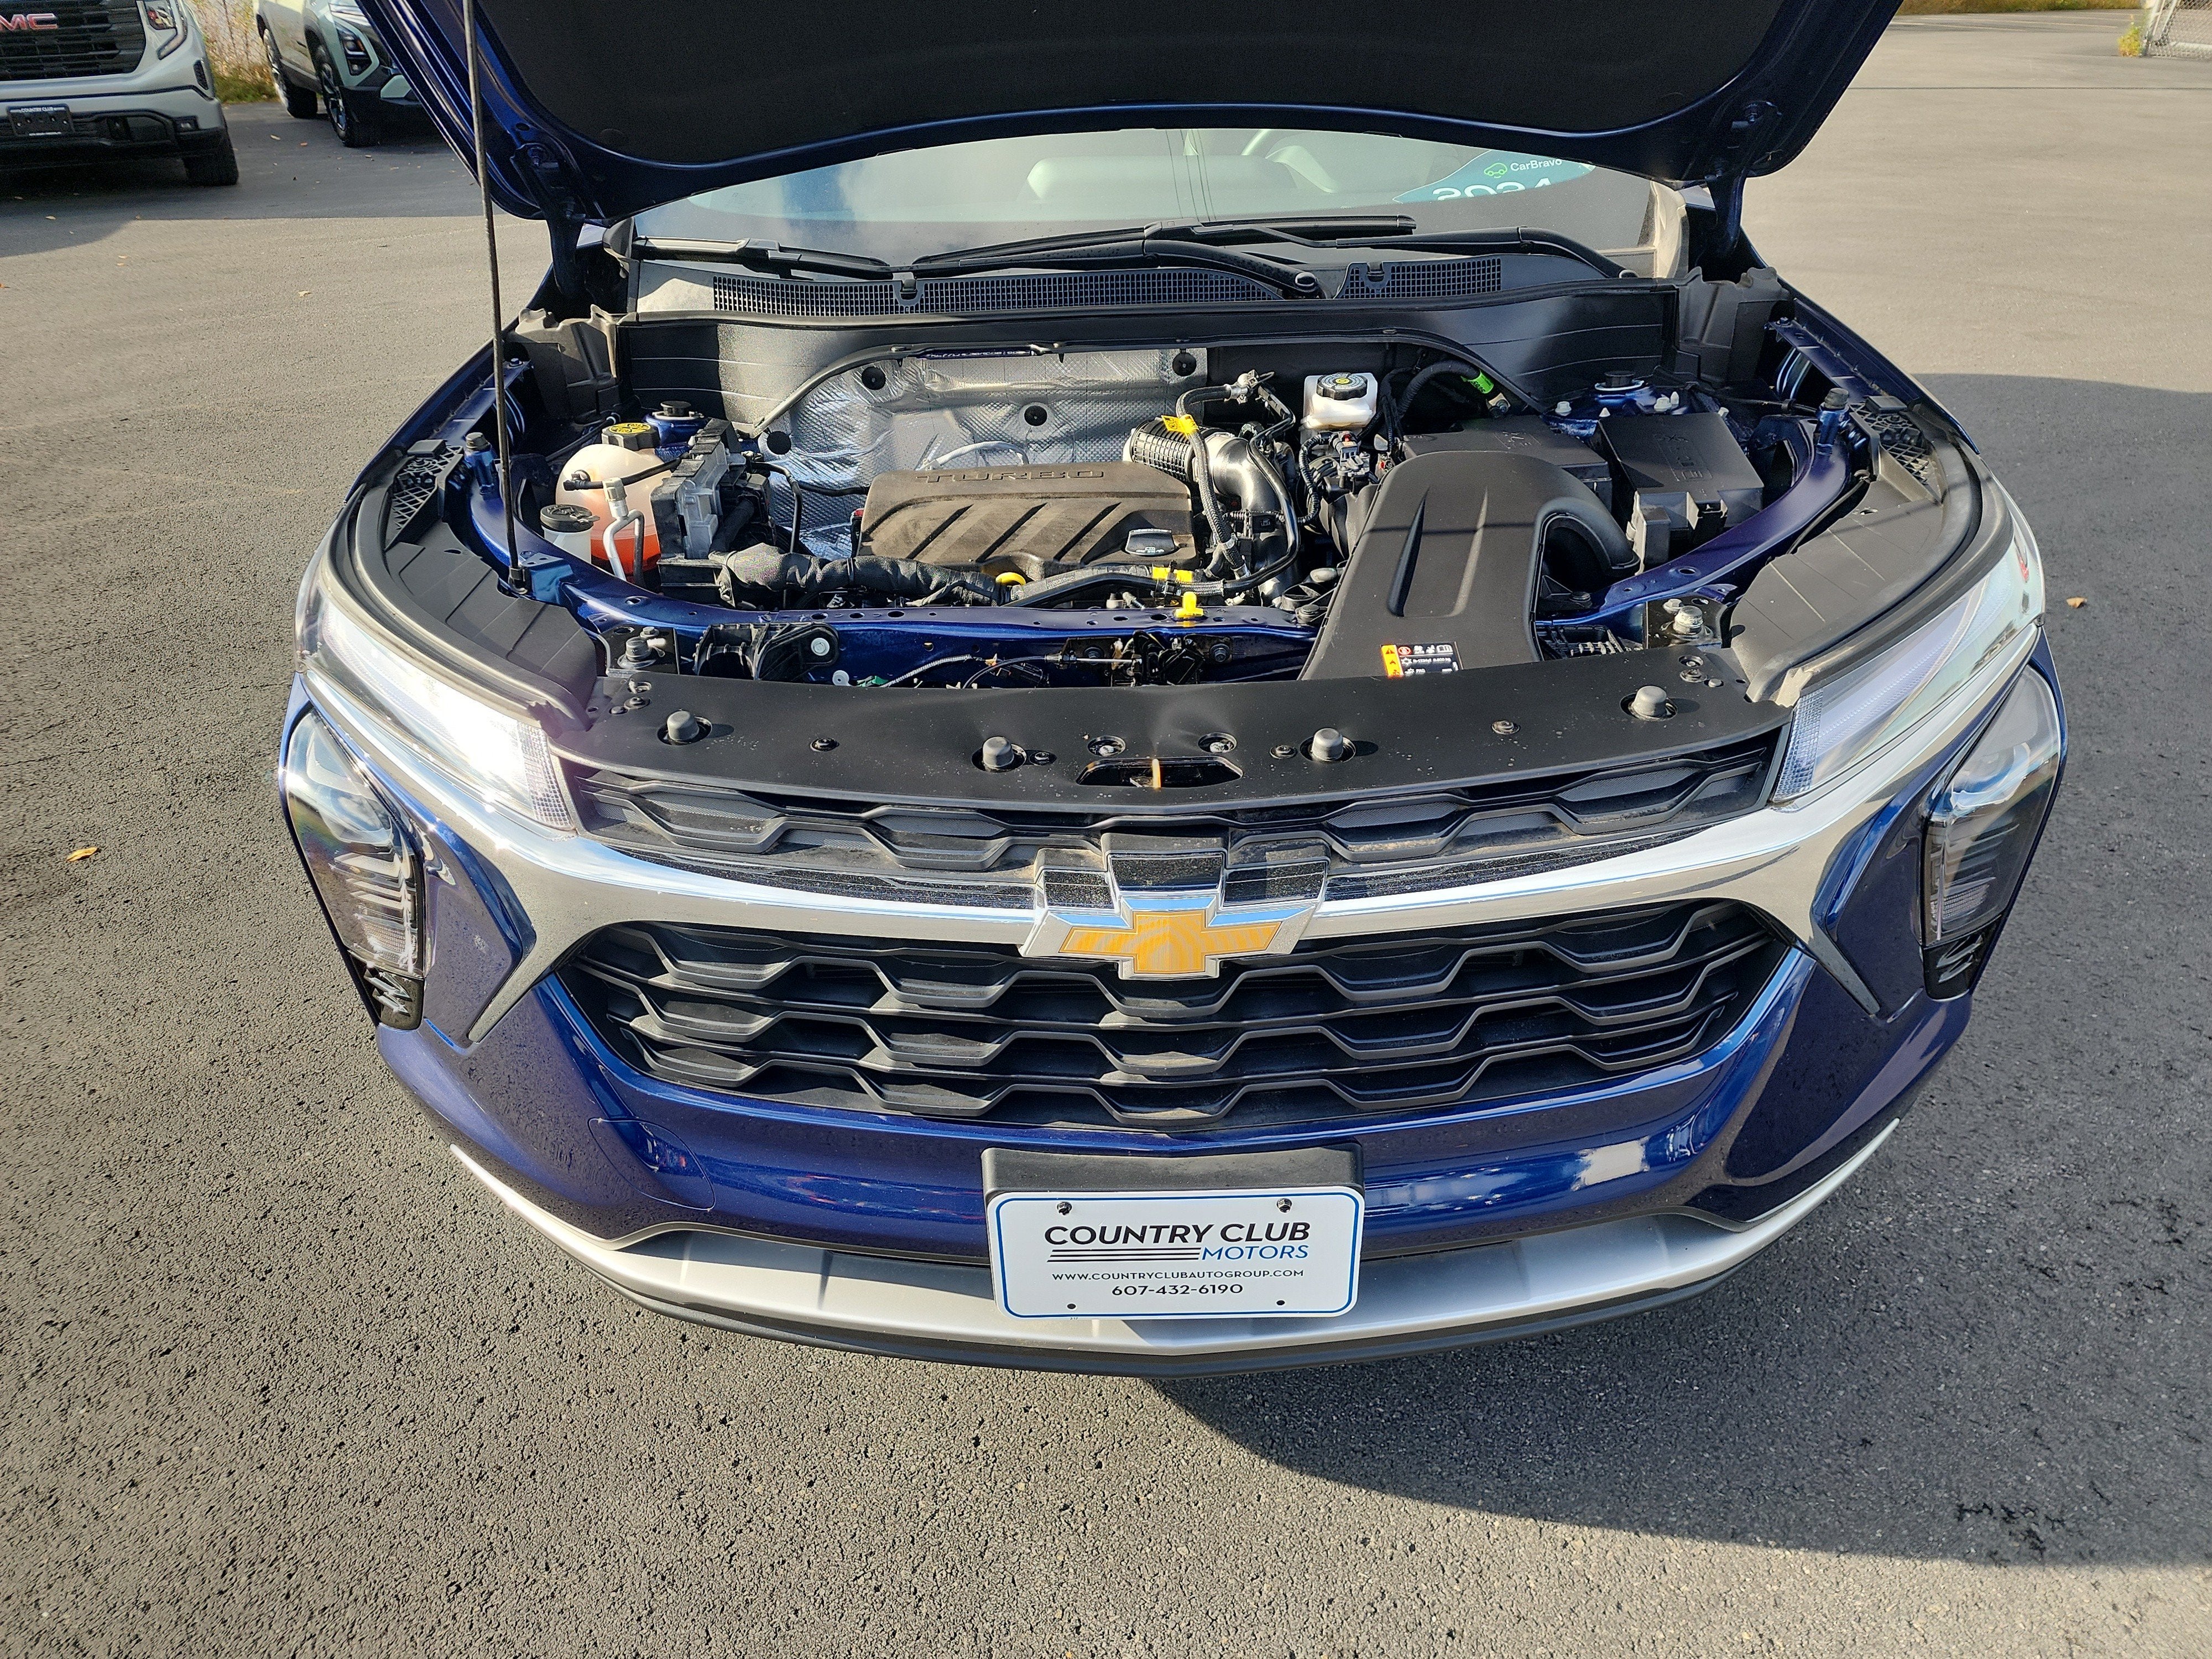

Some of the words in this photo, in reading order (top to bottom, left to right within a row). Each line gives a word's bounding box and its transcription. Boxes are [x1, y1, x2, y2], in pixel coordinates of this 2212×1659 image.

[0, 13, 58, 30] MC
[1510, 158, 1562, 171] CarBravo
[915, 471, 1104, 483] TURBO
[1045, 1224, 1214, 1245] COUNTRY
[1220, 1222, 1310, 1242] CLUB
[1202, 1245, 1309, 1260] MOTORS
[1052, 1270, 1303, 1280] WWW.COUNTRYCLUBAUTOGROUP.COM
[1112, 1284, 1243, 1295] 607-432-6190
